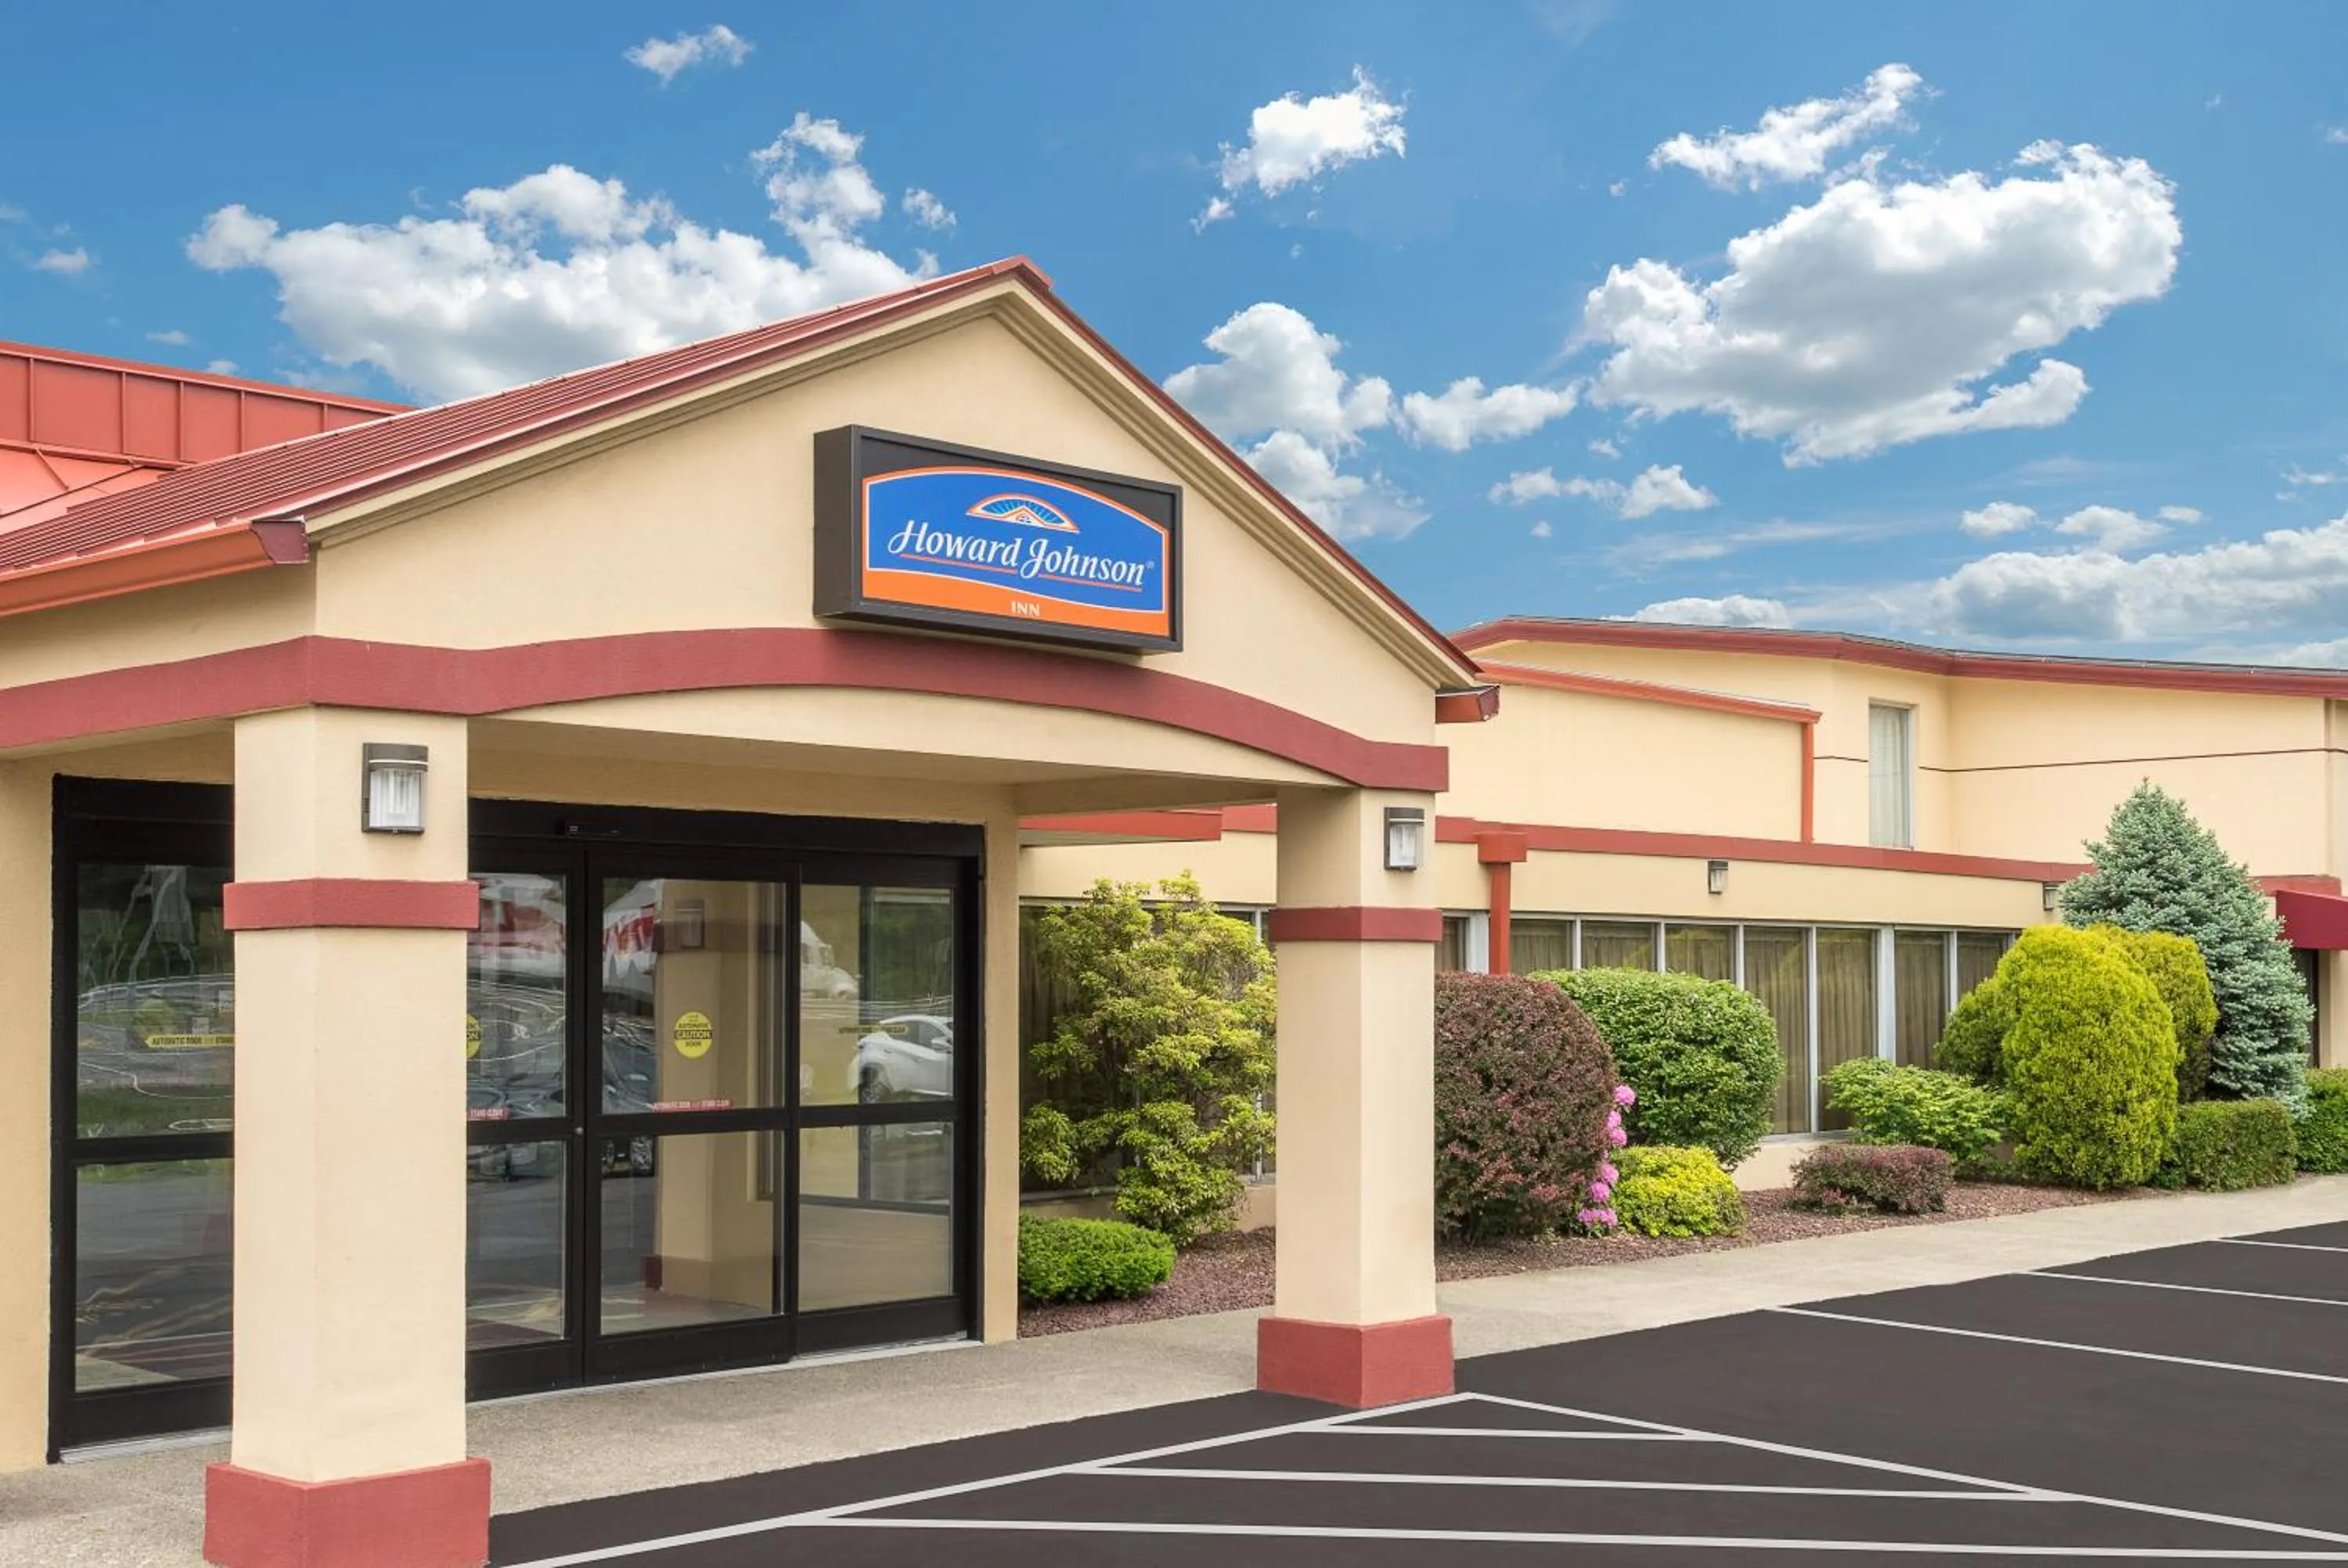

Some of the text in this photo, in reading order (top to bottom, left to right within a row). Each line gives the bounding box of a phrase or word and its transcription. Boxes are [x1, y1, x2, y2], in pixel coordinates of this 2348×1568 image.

[888, 520, 1143, 586] Howard Johnson
[1011, 601, 1040, 617] INN
[676, 1030, 710, 1039] CAUTION
